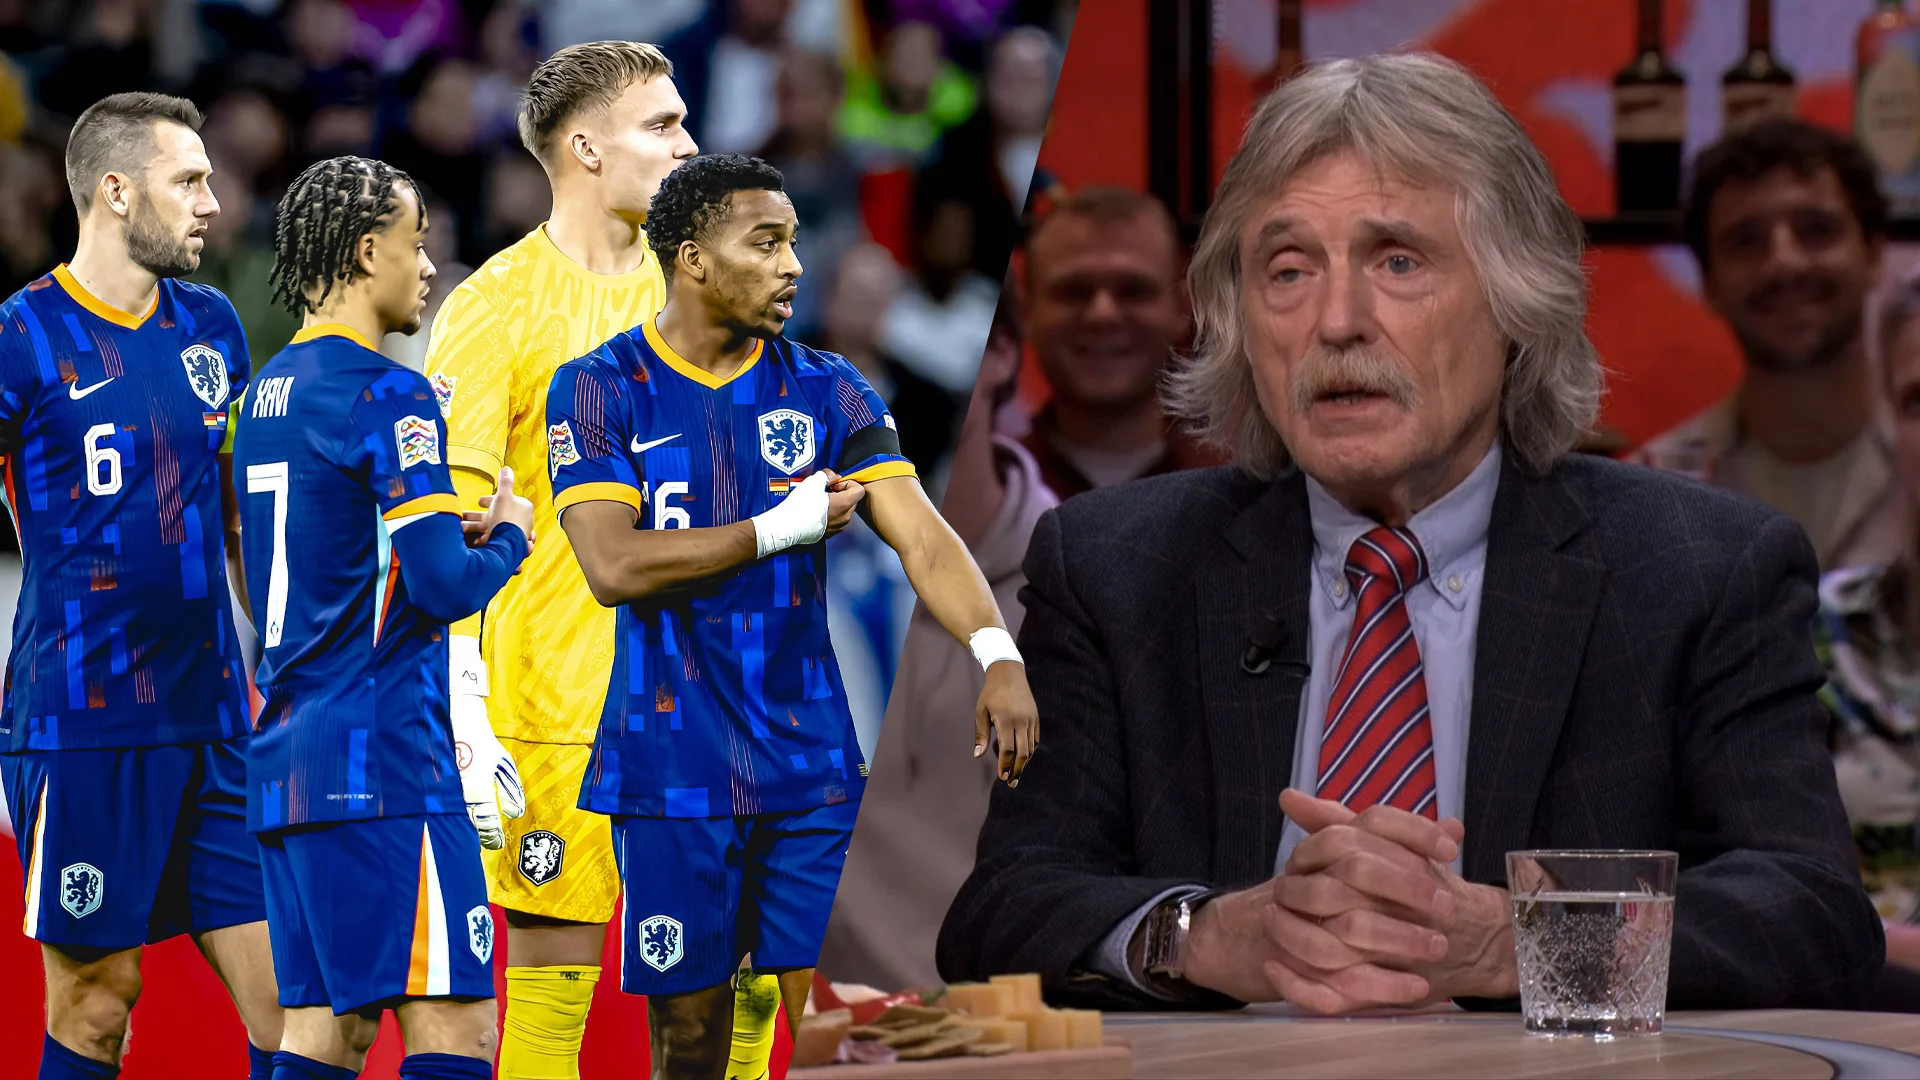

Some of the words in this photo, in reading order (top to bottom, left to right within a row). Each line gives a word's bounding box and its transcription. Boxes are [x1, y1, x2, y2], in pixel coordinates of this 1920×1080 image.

[252, 376, 295, 419] XAVI
[83, 422, 123, 496] 6
[247, 461, 289, 649] 7
